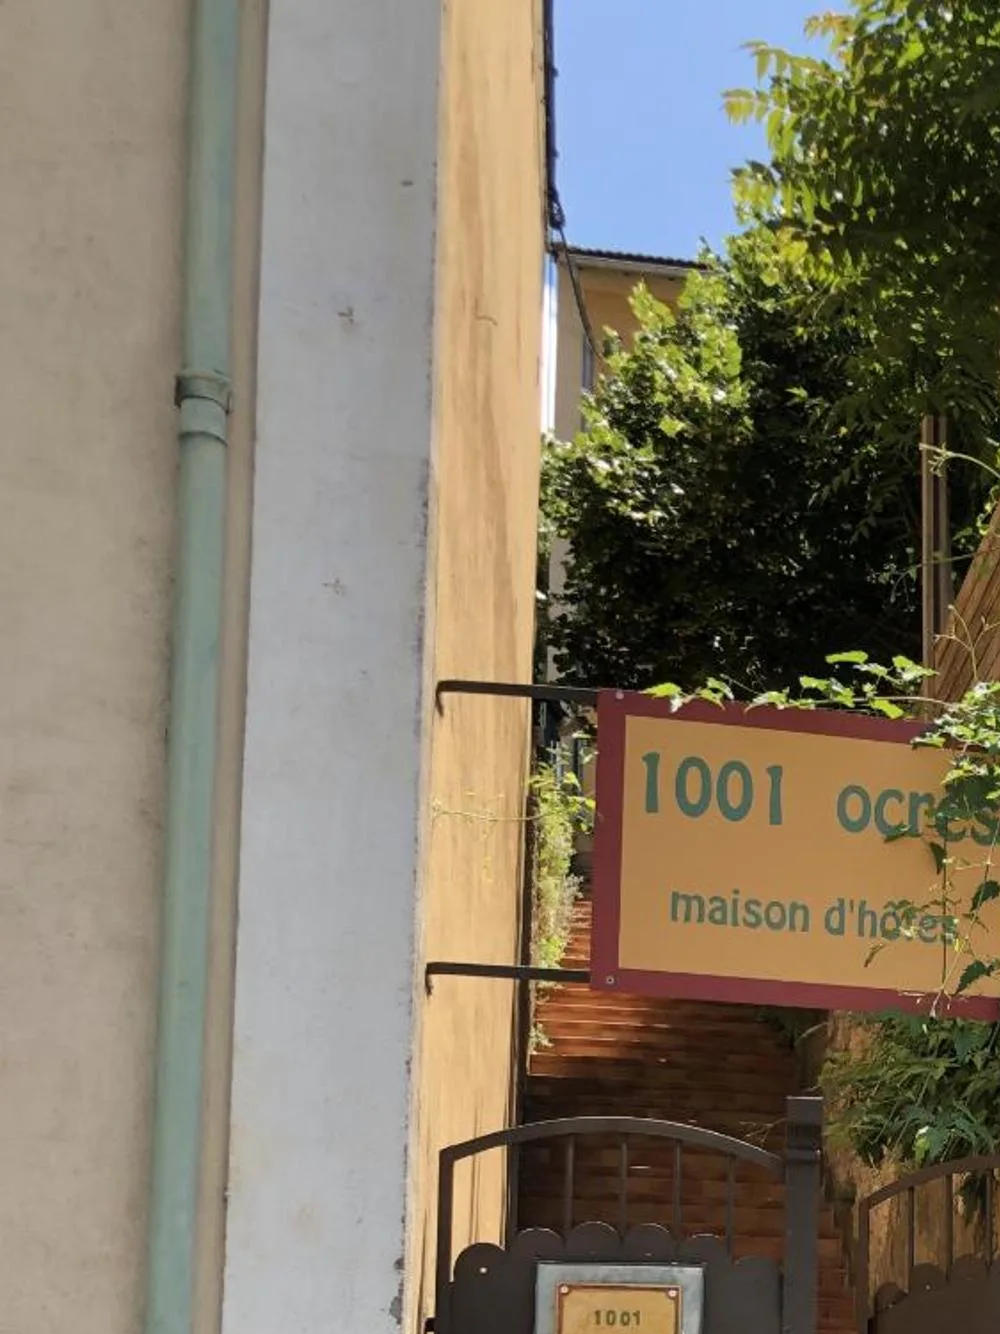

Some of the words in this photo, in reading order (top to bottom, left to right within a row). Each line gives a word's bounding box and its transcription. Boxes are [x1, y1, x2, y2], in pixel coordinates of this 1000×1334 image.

[642, 751, 784, 826] 1001
[670, 889, 810, 933] maison
[594, 1309, 641, 1327] 1001
